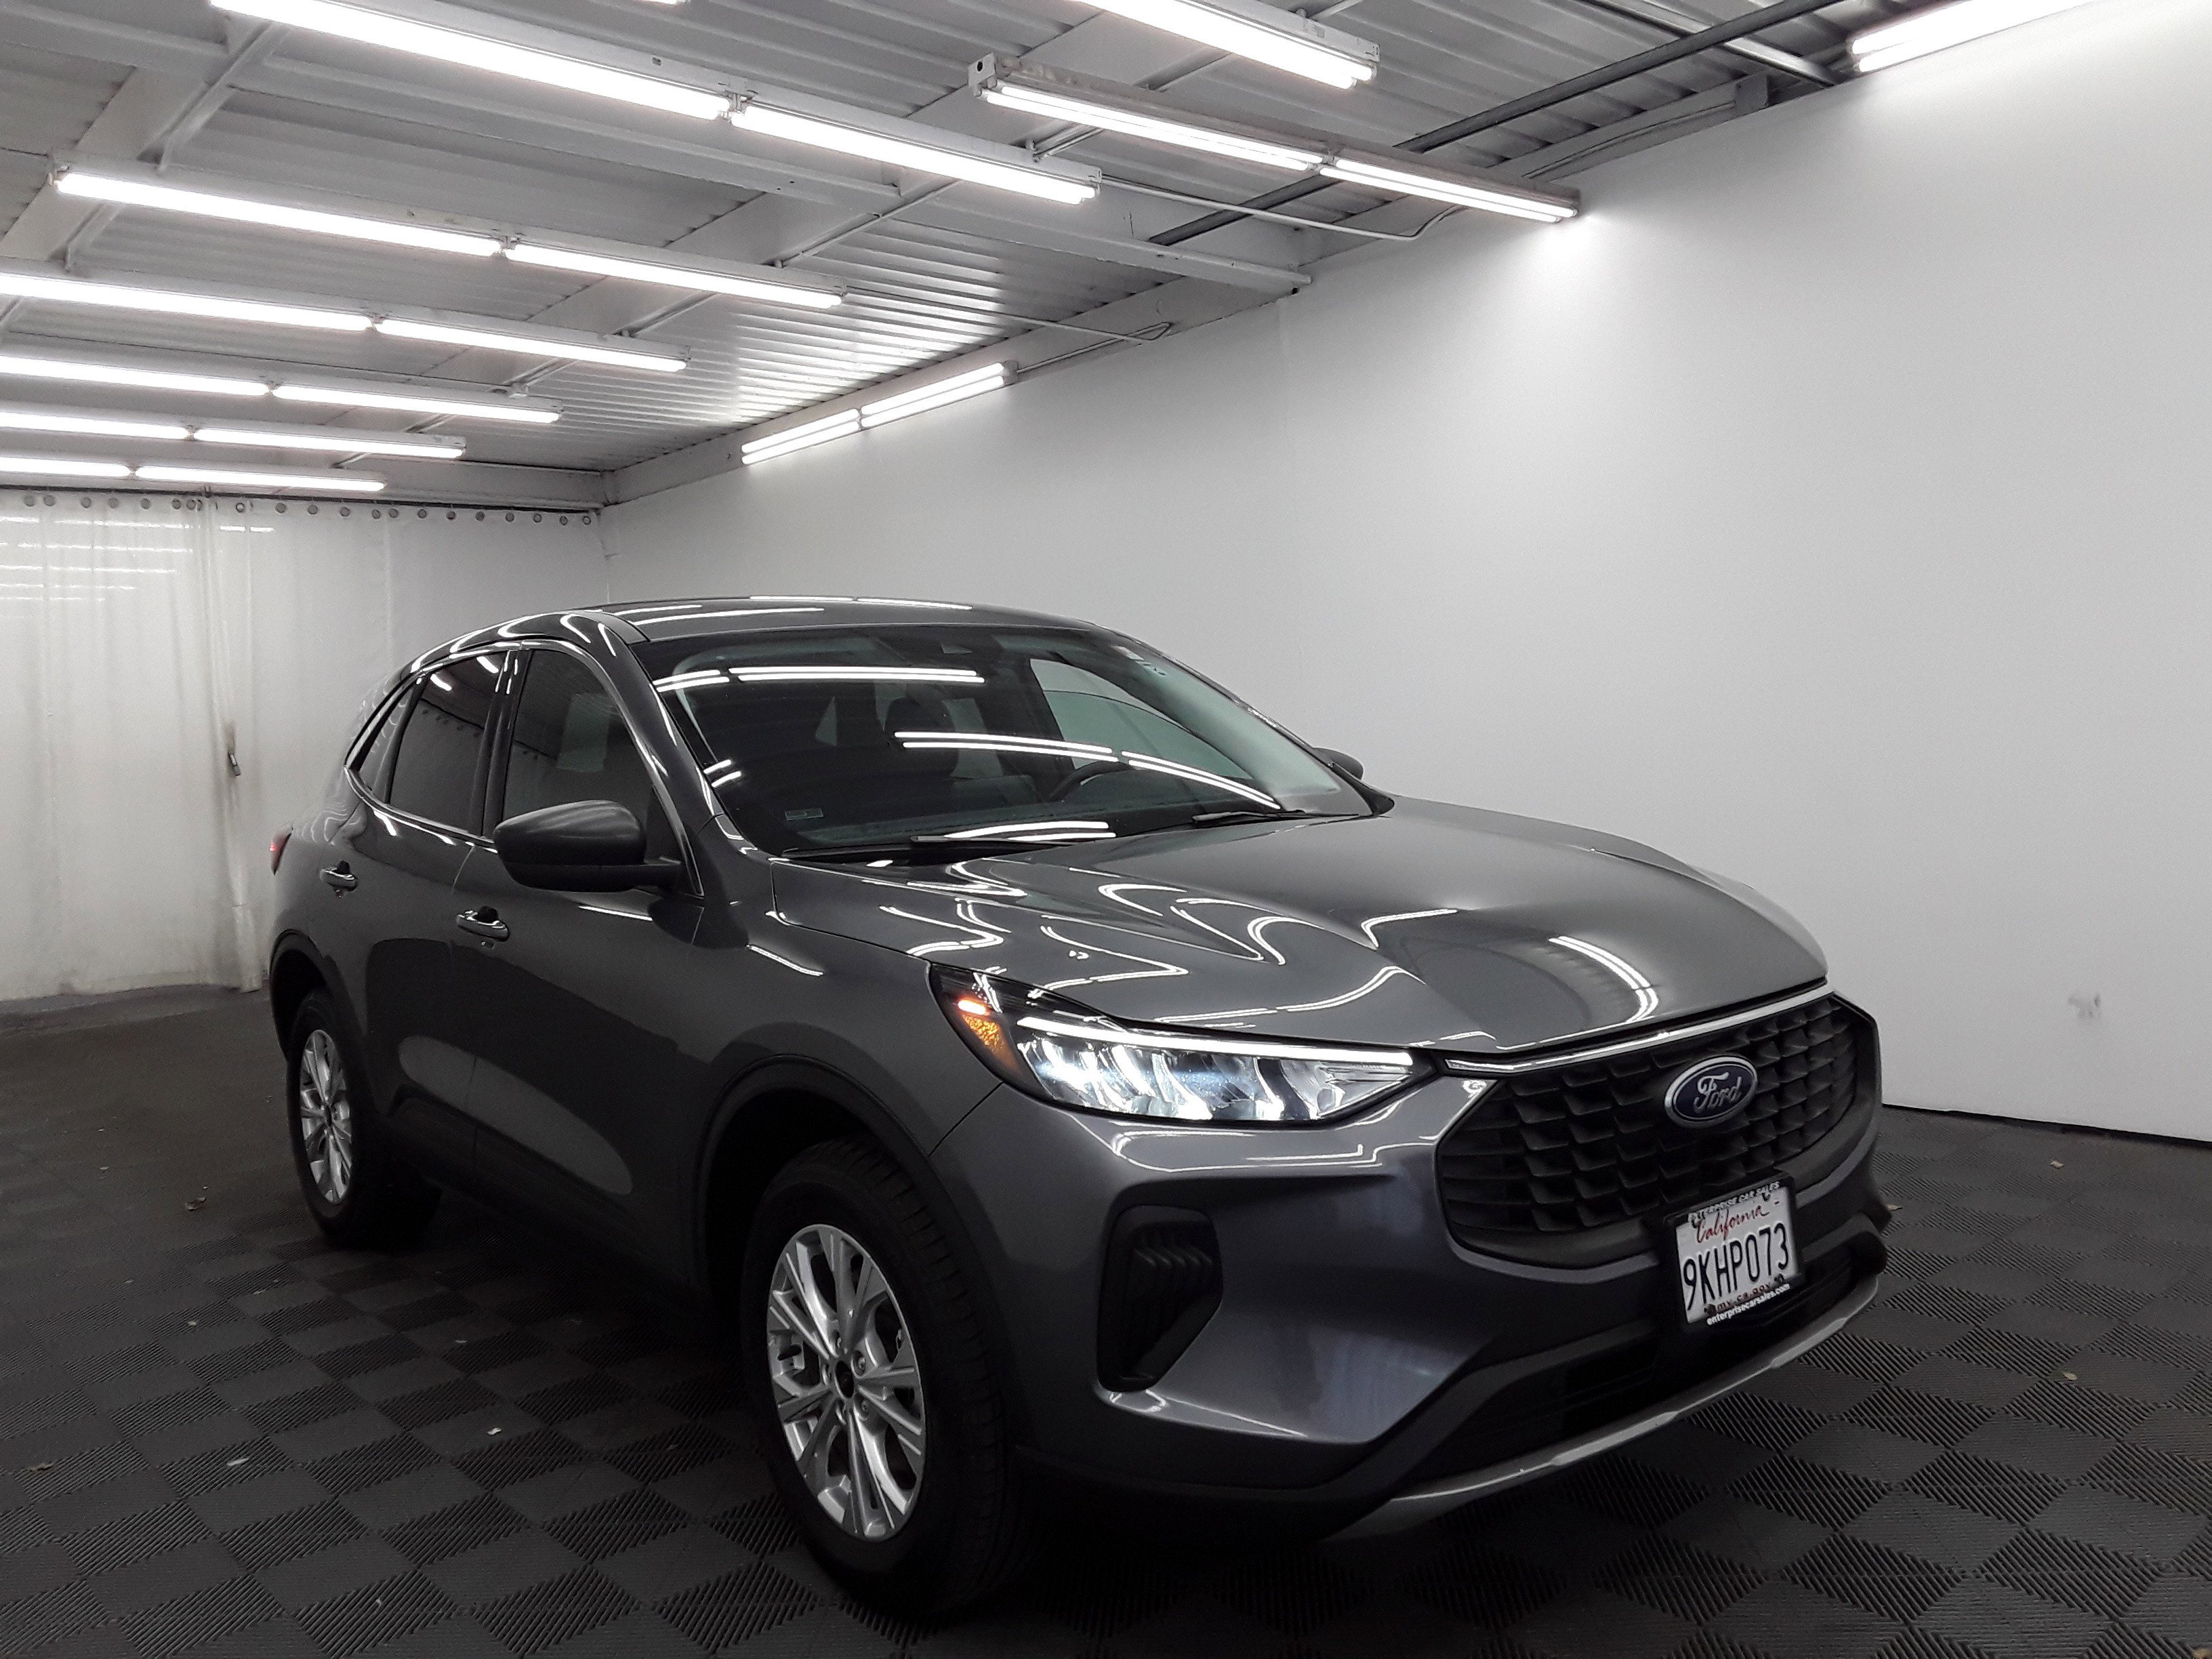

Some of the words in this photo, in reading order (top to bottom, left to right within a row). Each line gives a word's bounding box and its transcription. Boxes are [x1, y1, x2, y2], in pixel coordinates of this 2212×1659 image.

[1694, 1071, 1742, 1113] Ford
[1696, 1204, 1770, 1243] California
[1683, 1222, 1789, 1311] 9KHP073
[1706, 1283, 1790, 1326] enterprisecarsales.com
